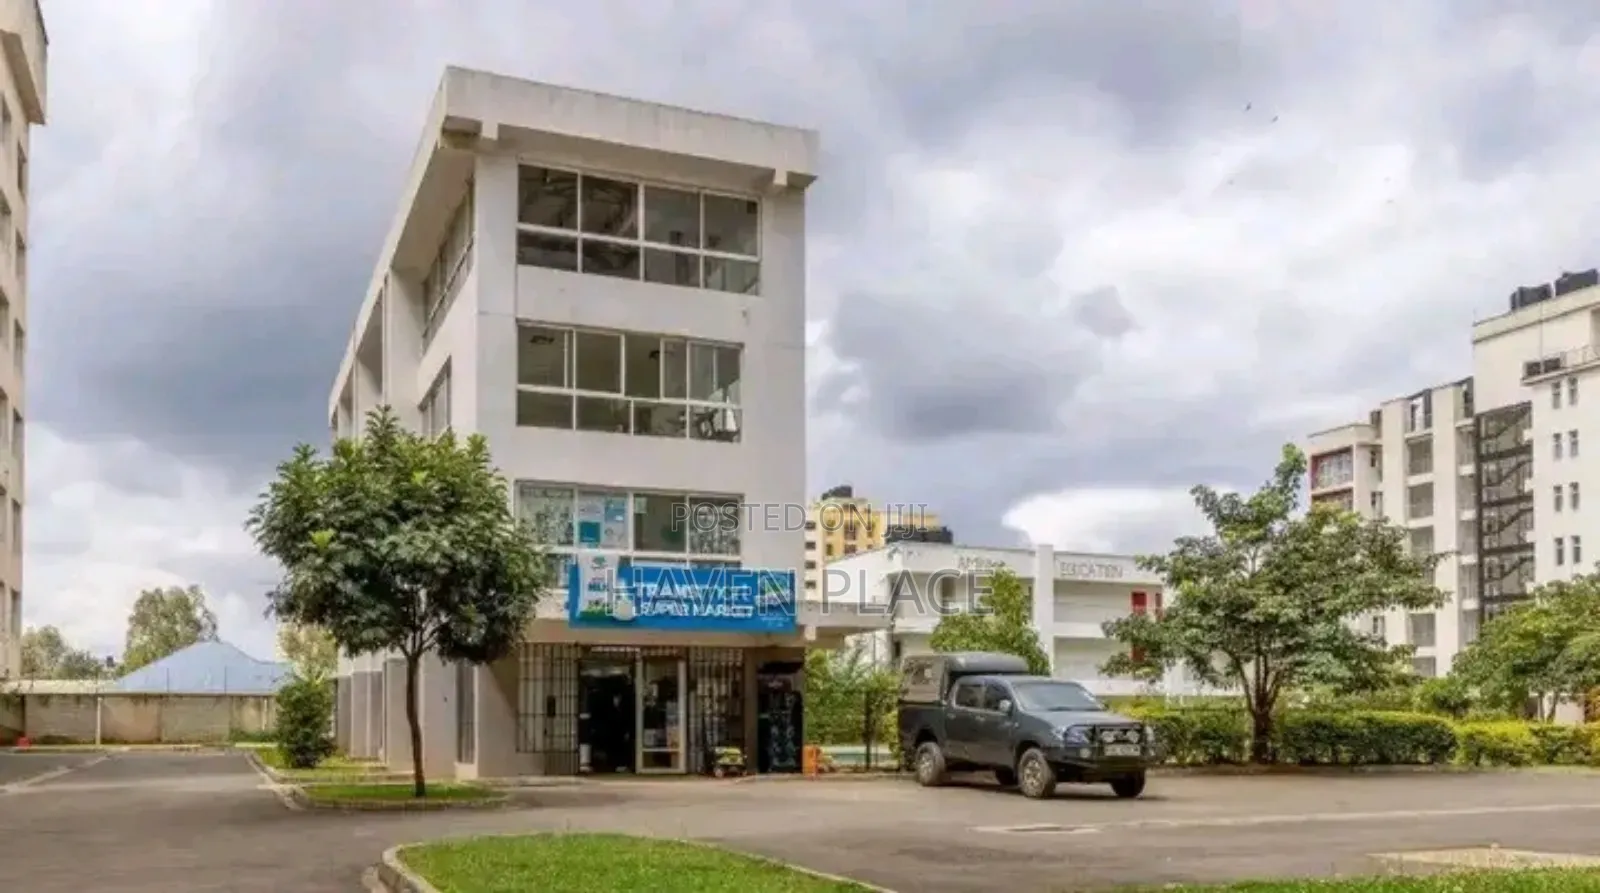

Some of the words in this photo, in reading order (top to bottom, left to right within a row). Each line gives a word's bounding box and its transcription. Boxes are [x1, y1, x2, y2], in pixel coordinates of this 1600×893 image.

[1060, 562, 1123, 578] EDUCATION
[641, 601, 690, 617] SUPER
[693, 603, 754, 619] MARKET
